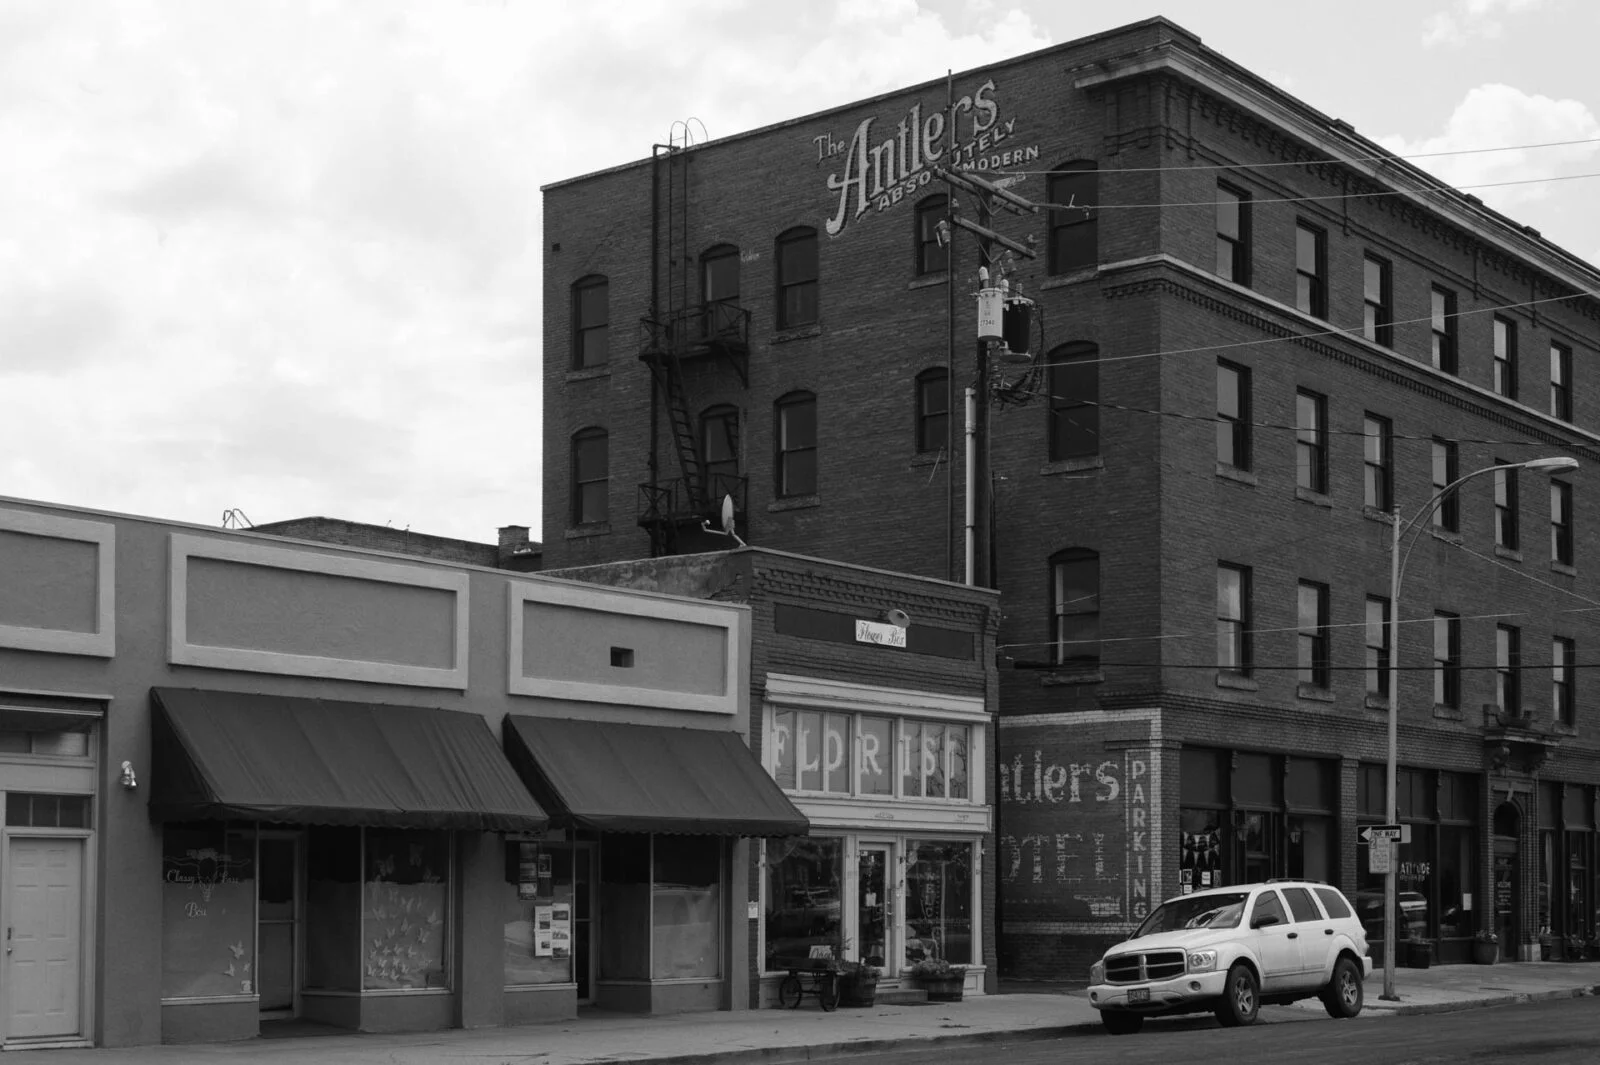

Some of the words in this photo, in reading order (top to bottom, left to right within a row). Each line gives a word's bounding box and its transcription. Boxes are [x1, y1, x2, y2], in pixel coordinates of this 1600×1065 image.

[813, 132, 845, 161] The
[826, 79, 1001, 236] Antlers
[878, 117, 1016, 211] ABSOUTELY
[962, 145, 1040, 171] MODERN
[1131, 760, 1148, 919] PARKING
[1384, 830, 1398, 838] WAY
